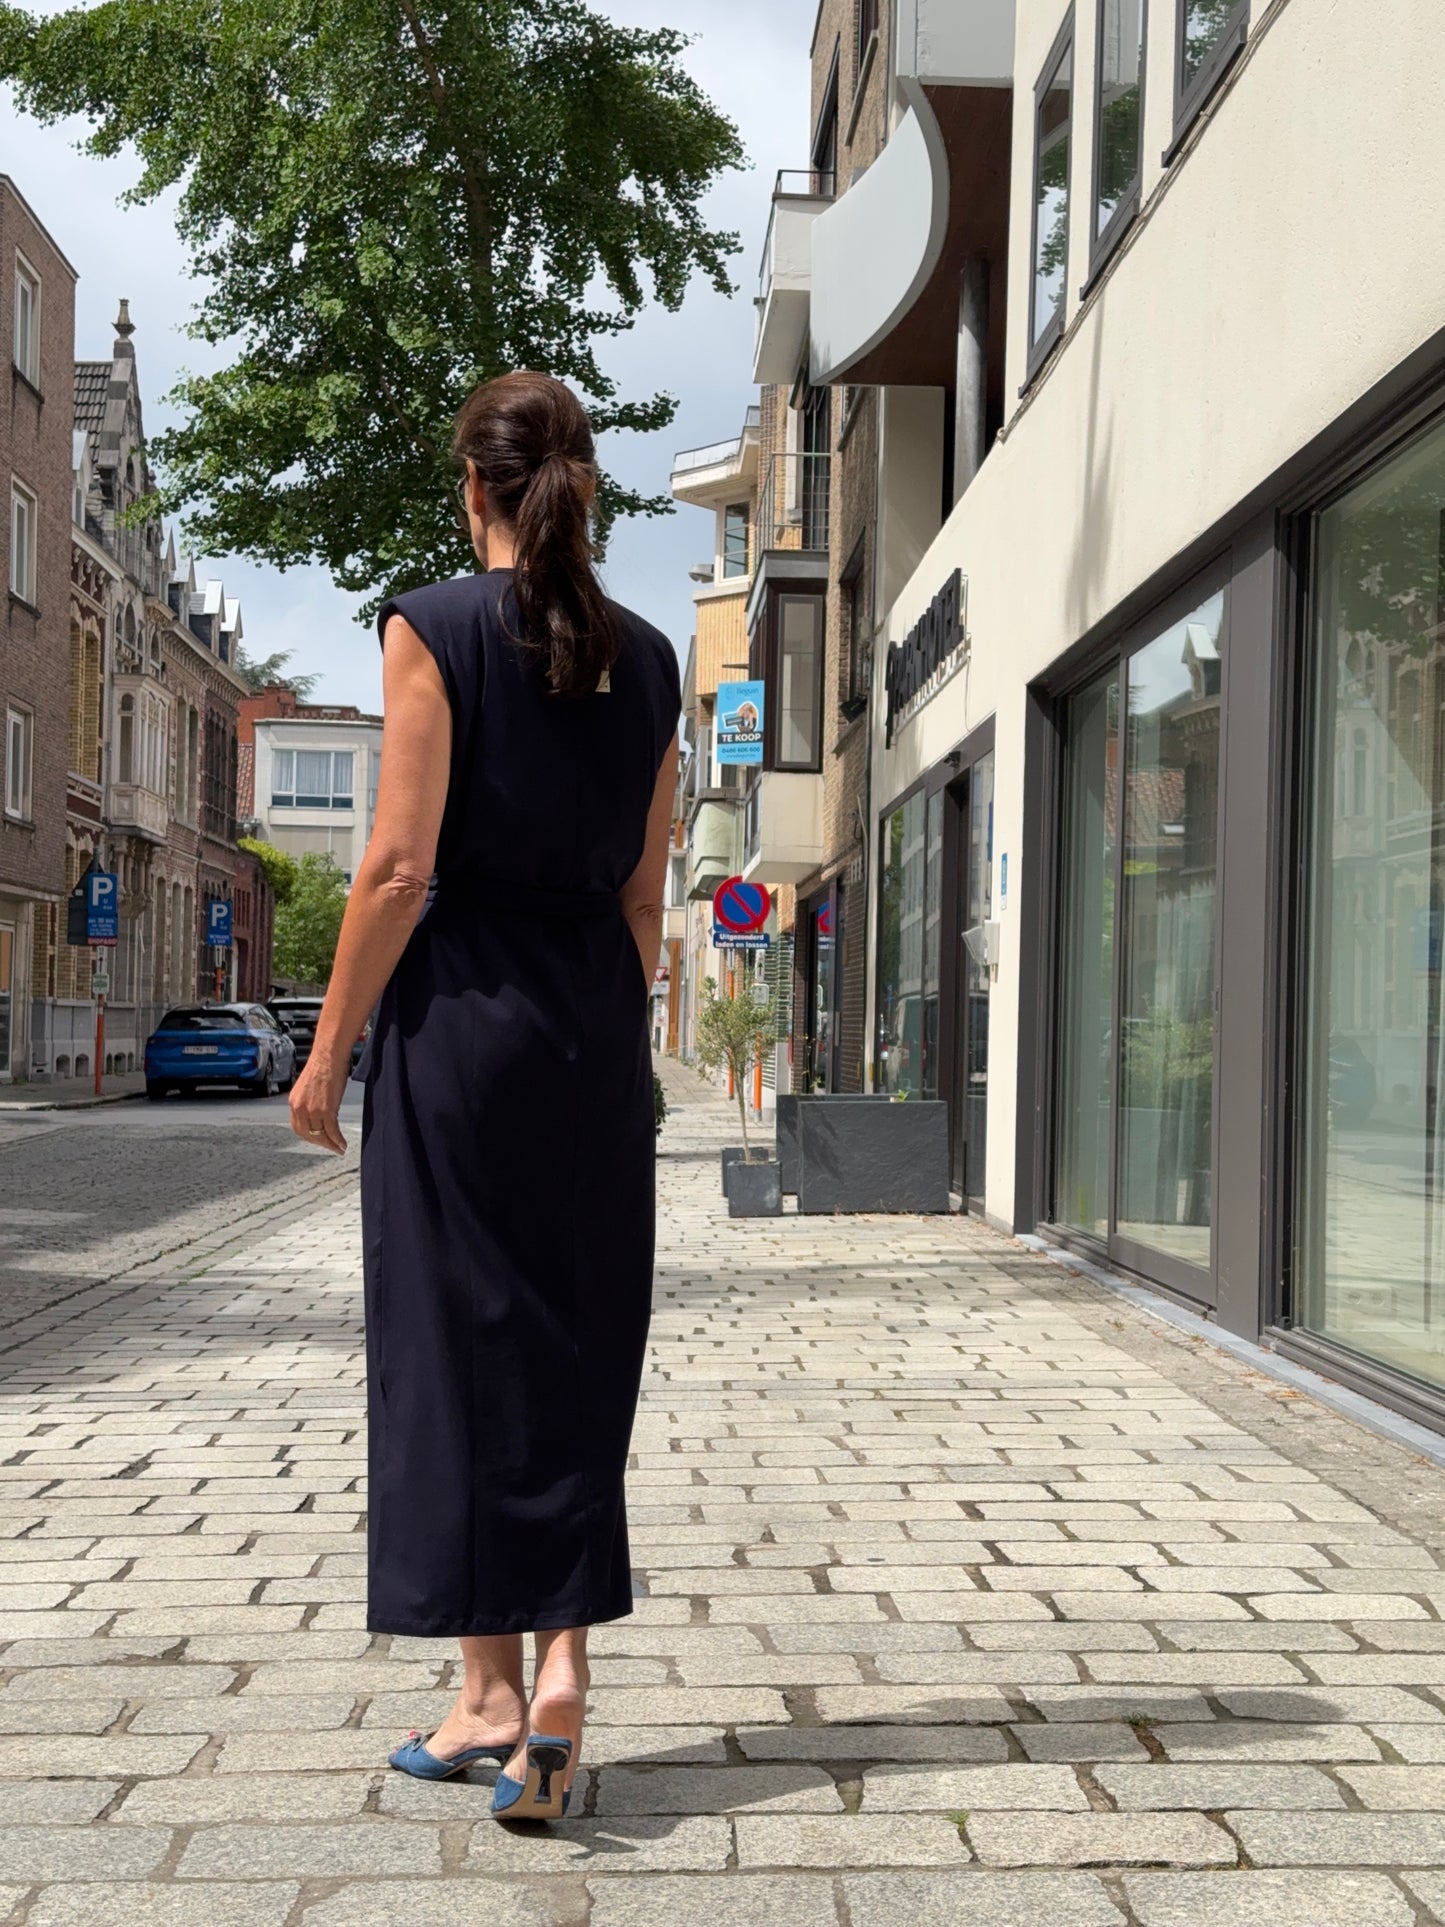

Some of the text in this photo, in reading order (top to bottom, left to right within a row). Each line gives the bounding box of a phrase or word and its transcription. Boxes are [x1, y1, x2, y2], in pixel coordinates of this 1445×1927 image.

[722, 733, 761, 743] TE KOOP
[92, 877, 114, 906] P
[211, 904, 228, 927] P
[719, 934, 764, 942] Uitgezonderd
